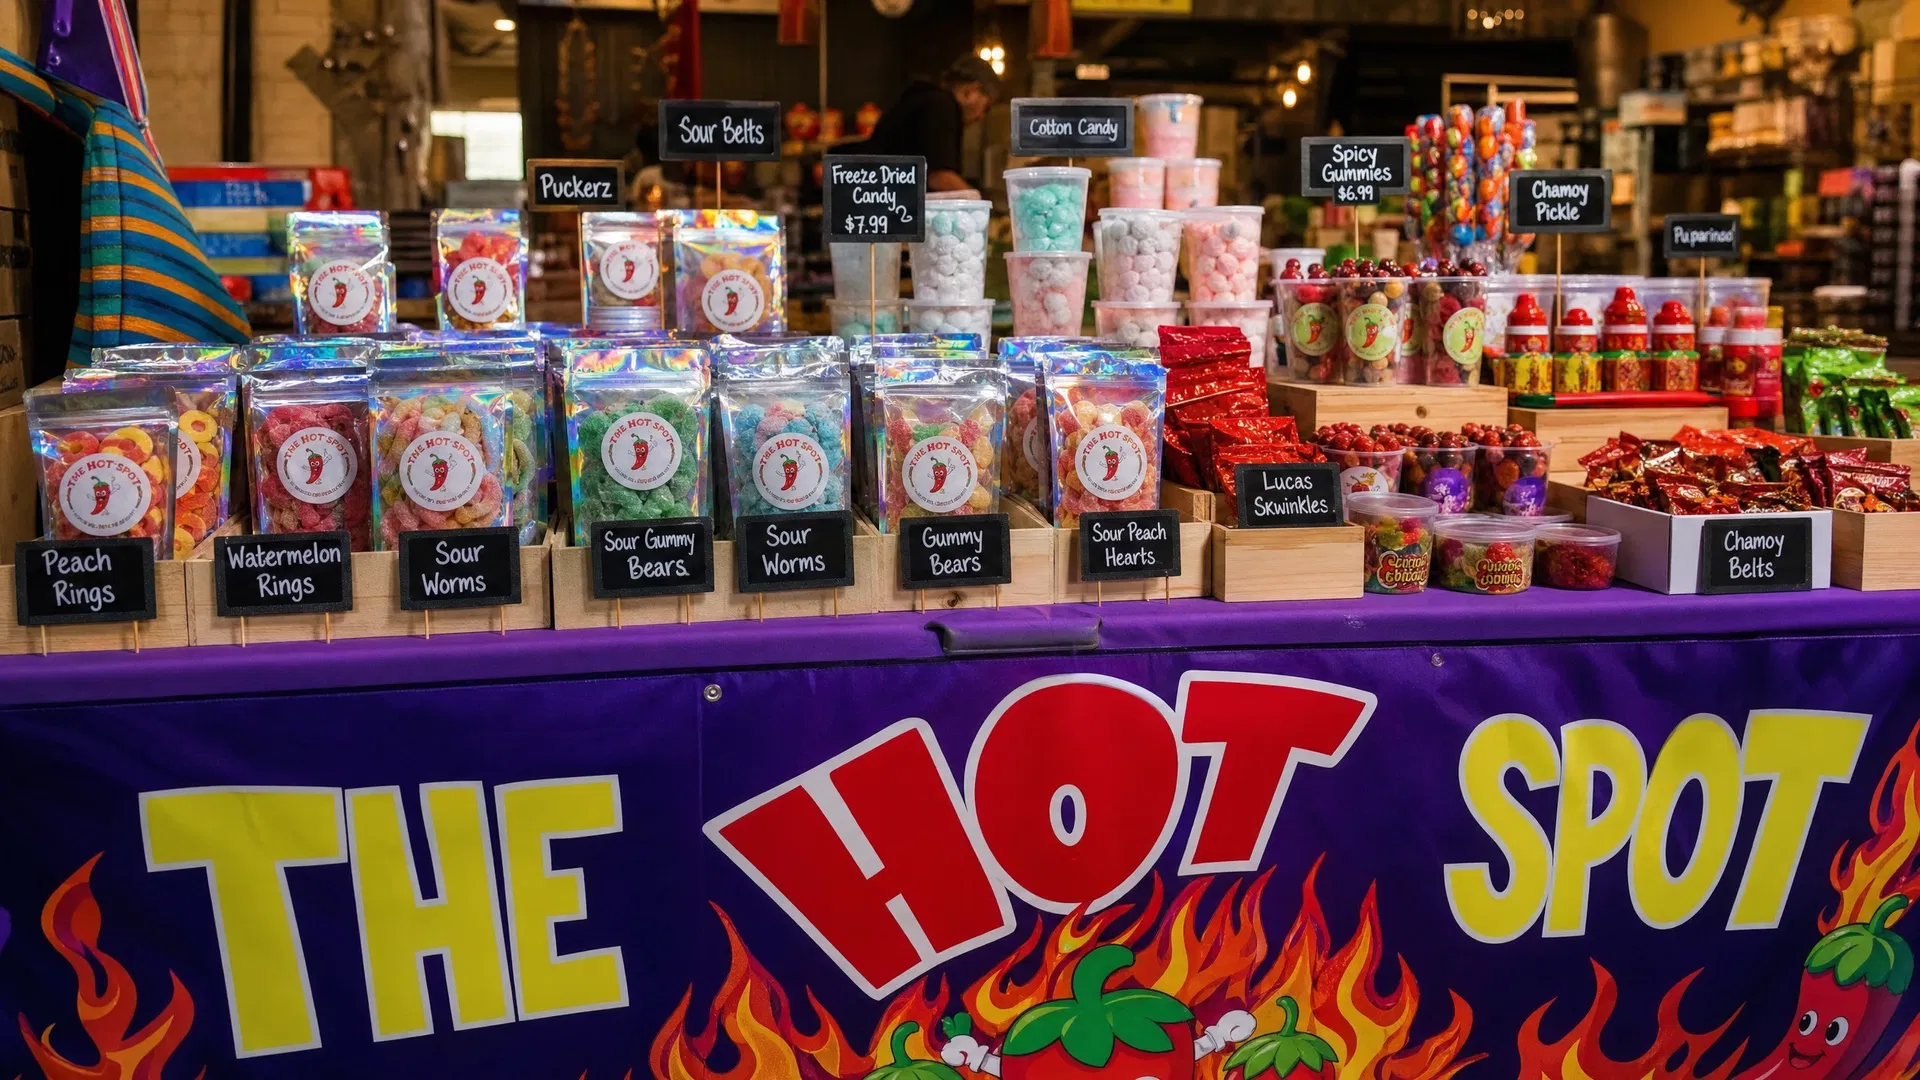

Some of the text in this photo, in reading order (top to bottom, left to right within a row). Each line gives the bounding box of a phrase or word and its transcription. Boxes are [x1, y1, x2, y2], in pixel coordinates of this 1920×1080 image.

[679, 115, 765, 145] Sour Belts
[1029, 117, 1119, 141] Cotton Candy
[1331, 144, 1378, 169] Spicy
[832, 165, 916, 185] Freeze Dried
[1321, 162, 1393, 182] Gummies
[539, 173, 613, 199] Puckerz
[1337, 185, 1374, 202] $6.99
[1531, 180, 1589, 207] Chamoy
[852, 186, 897, 212] Candy
[1535, 201, 1581, 222] Pickle
[844, 214, 888, 234] $7.99
[329, 264, 349, 273] HOT
[469, 263, 488, 271] HOT
[610, 418, 674, 444] THE HOT SPOT
[1083, 431, 1142, 455] THE HOT SPOT
[284, 432, 348, 459] THE HOT SPOT
[408, 437, 475, 464] THE HOT SPOT
[760, 438, 822, 465] THE HOT SPOT
[910, 441, 971, 467] THE HOT SPOT
[67, 459, 142, 488] THE HOT SPOT
[1262, 471, 1313, 491] Lucas
[604, 528, 695, 556] Sour Gummy
[766, 524, 812, 547] Sour
[922, 527, 983, 554] Gummy
[1092, 521, 1167, 543] Sour Peach
[1724, 530, 1785, 557] Chamoy
[42, 549, 112, 575] Peach
[227, 542, 341, 569] Watermelon
[435, 541, 485, 565] Sour
[761, 552, 826, 576] Worms
[929, 554, 982, 576] Bears
[1105, 546, 1156, 567] Hearts
[627, 555, 690, 580] Bears
[1728, 557, 1775, 579] Belts
[53, 580, 115, 612] Rings
[257, 573, 315, 602] Rings
[421, 572, 487, 595] Worms
[139, 671, 1872, 1059] THE HOT SPOT
